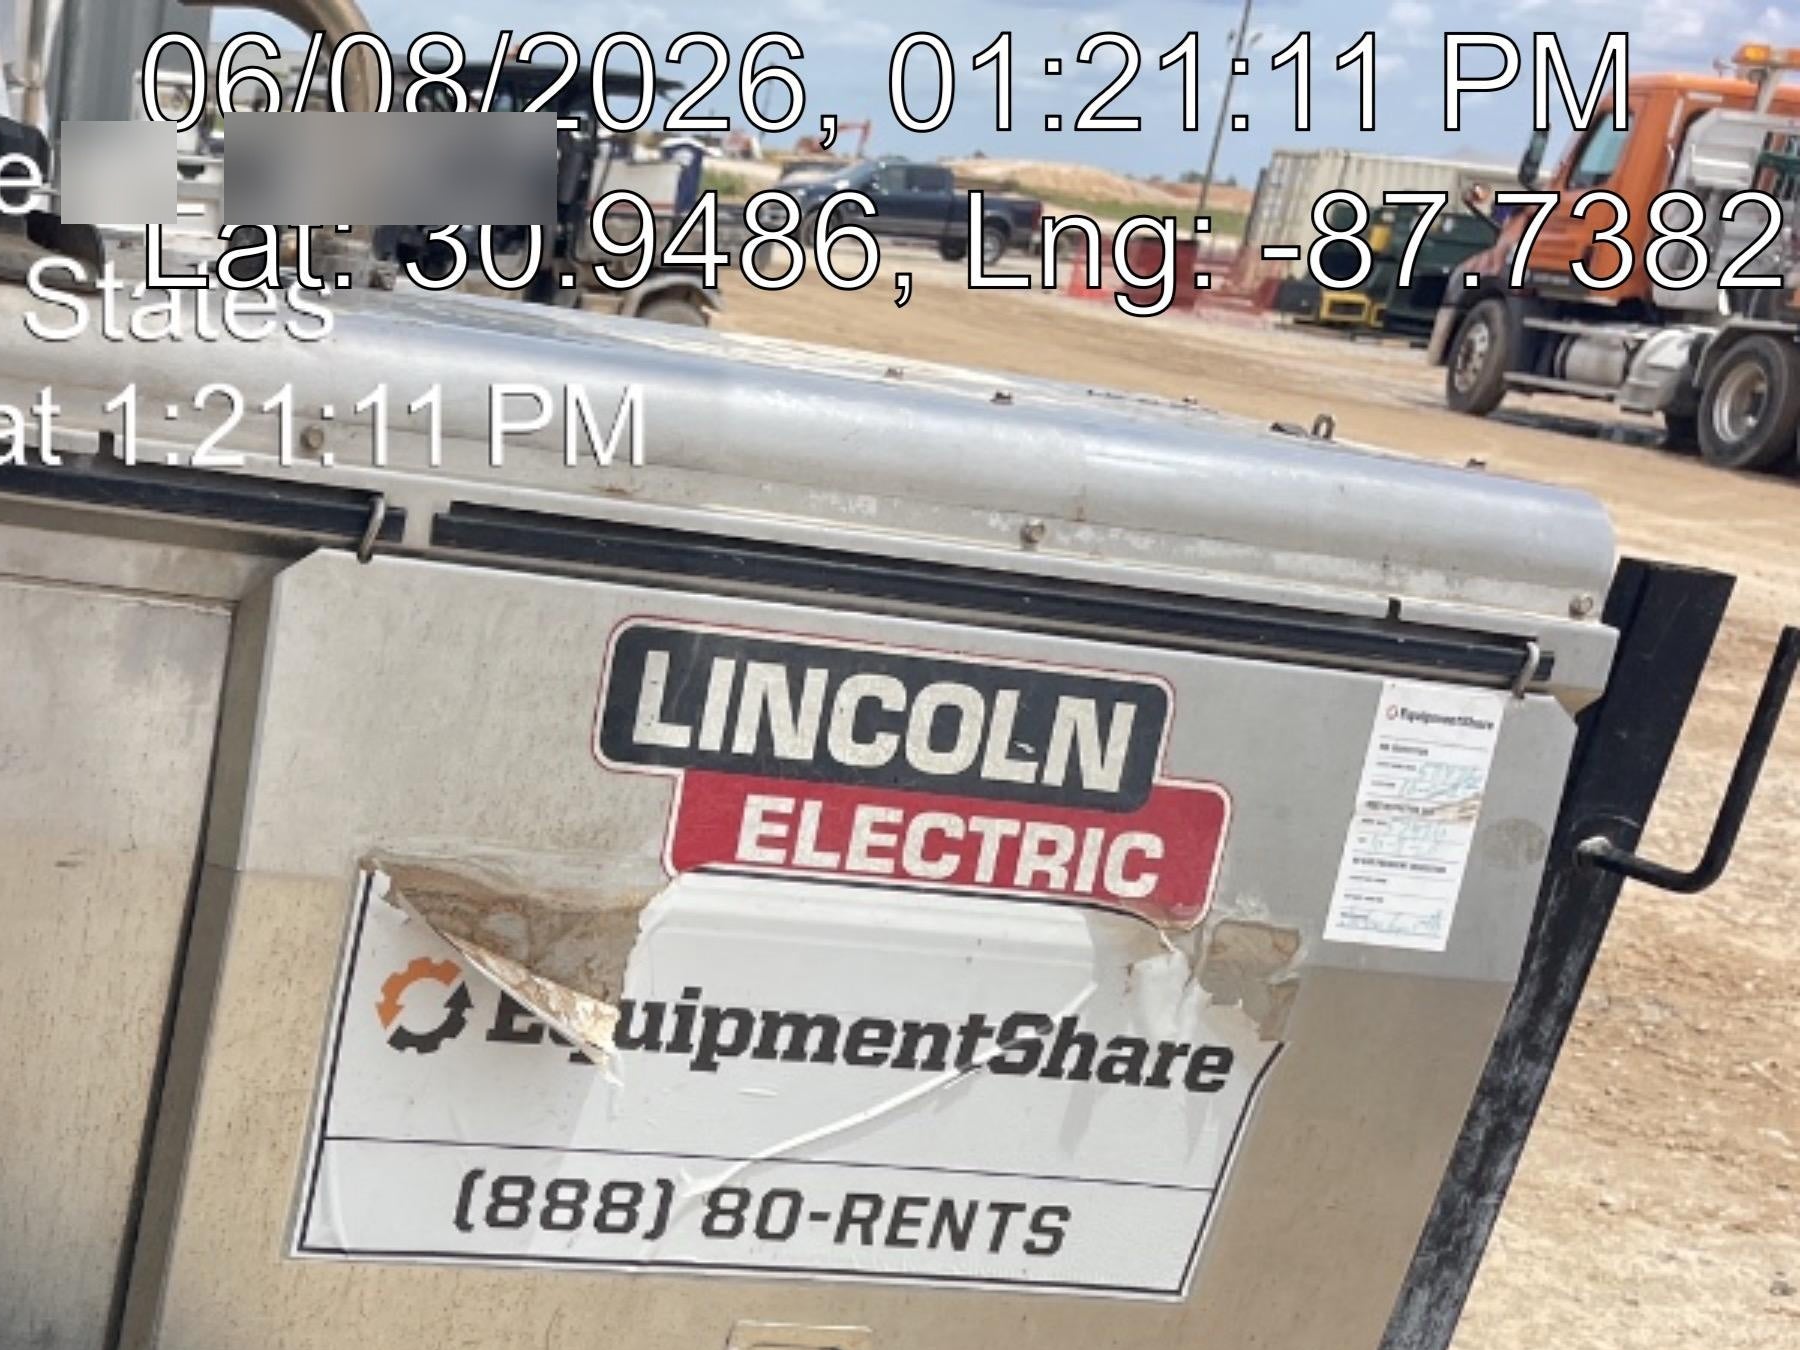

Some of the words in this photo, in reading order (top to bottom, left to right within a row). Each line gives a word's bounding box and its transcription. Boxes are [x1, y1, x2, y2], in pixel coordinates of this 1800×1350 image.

[632, 650, 1137, 793] LINCOLN
[735, 794, 1164, 899] ELECTRIC
[484, 985, 1235, 1095] EuipmentShare
[452, 1169, 674, 1244] (888)
[700, 1186, 1073, 1258] 80-RENTS
